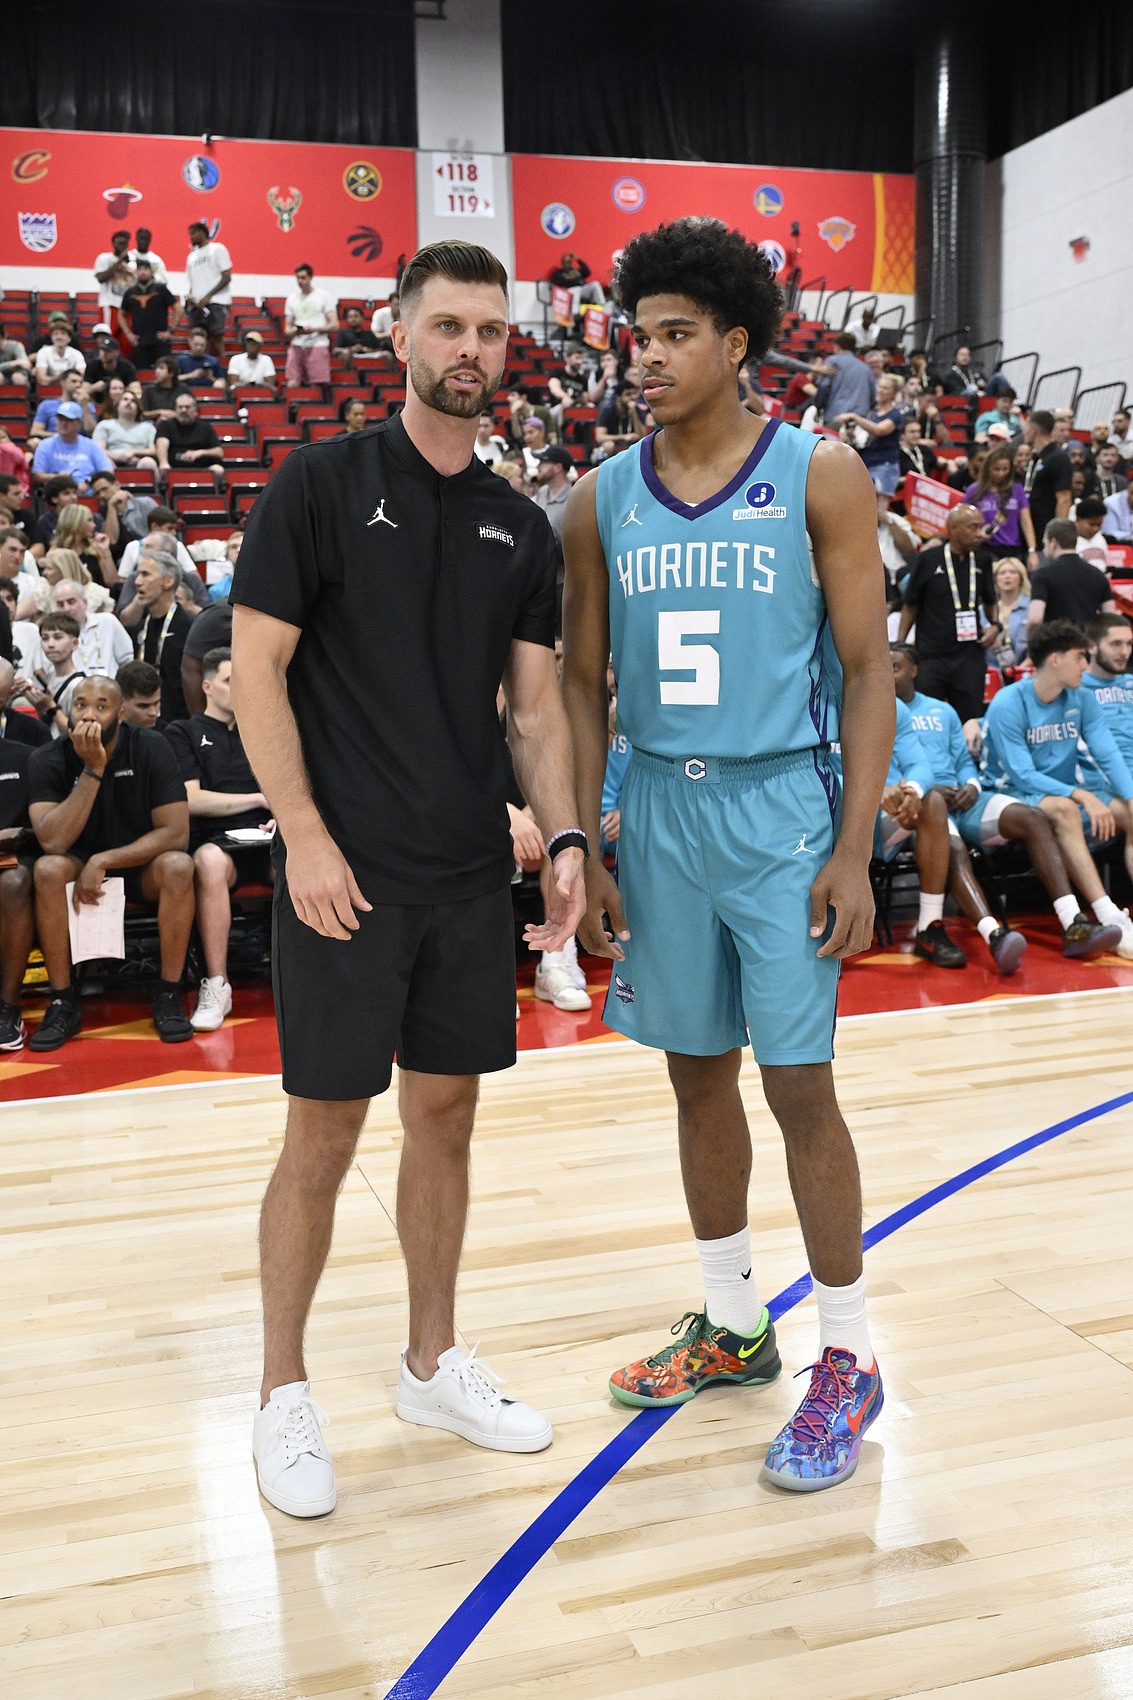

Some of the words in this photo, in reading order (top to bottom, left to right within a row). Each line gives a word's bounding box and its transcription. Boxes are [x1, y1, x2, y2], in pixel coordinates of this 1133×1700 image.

[447, 163, 477, 182] 118
[448, 194, 479, 213] 119
[479, 526, 515, 547] HORNETS
[616, 541, 778, 599] HORNETS
[658, 610, 721, 706] 5
